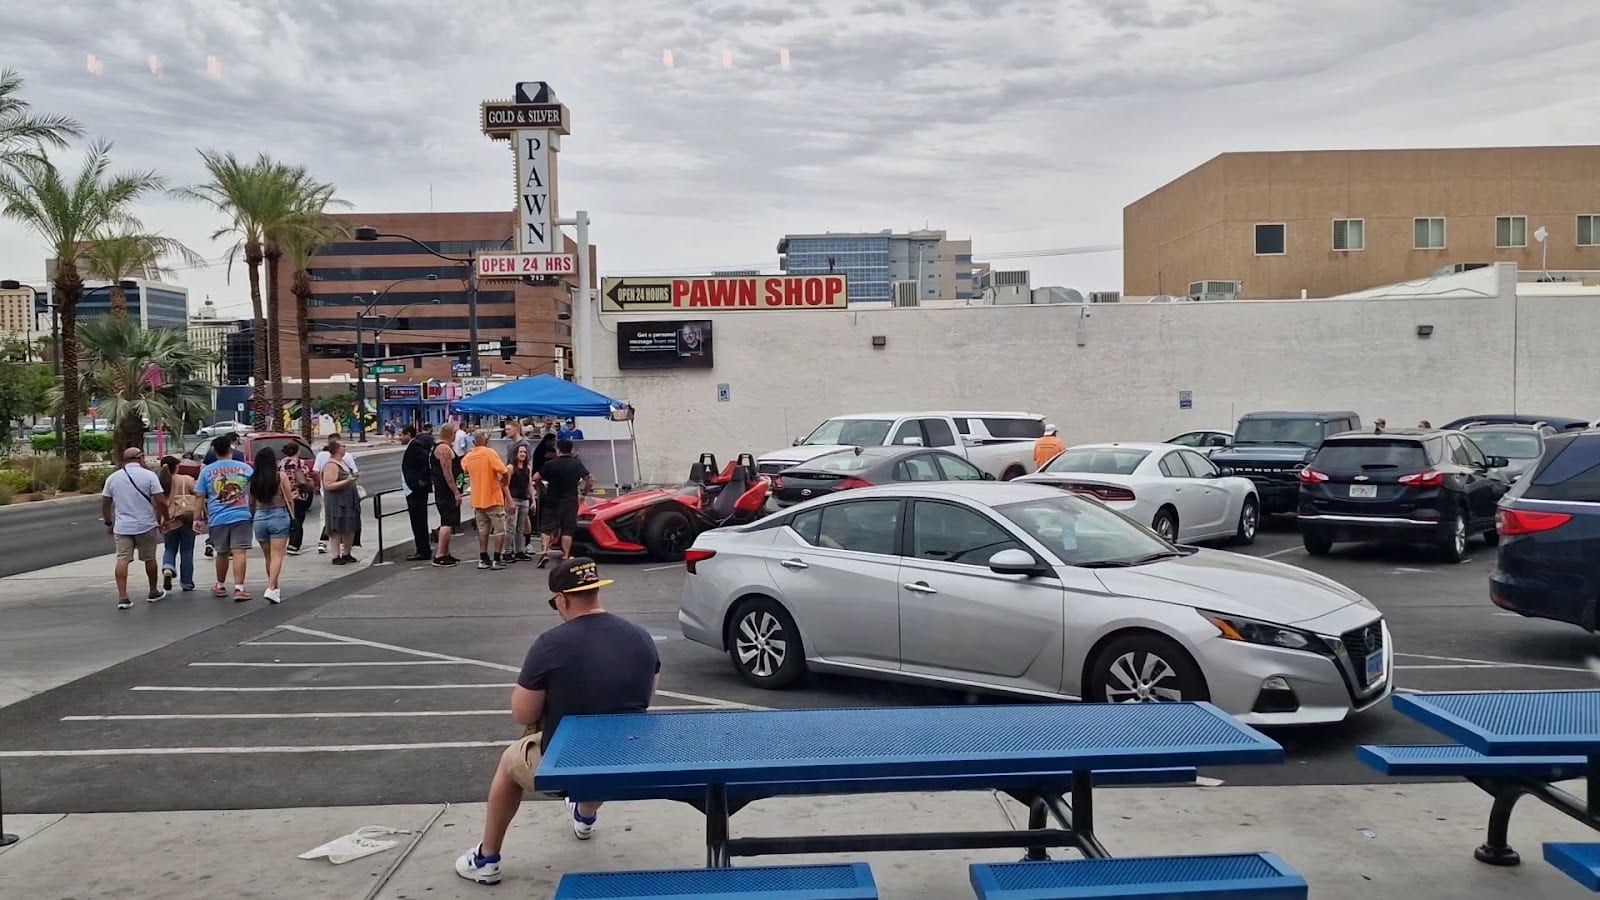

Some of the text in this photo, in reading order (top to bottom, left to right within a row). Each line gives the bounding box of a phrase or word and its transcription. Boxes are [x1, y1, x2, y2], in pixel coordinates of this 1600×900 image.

[488, 109, 560, 123] GOLD & SILVER
[523, 138, 547, 245] PAWN
[482, 256, 571, 272] OPEN 24 HRS
[617, 287, 670, 302] OPEN 24 HOURS
[672, 277, 843, 307] PAWN SHOP
